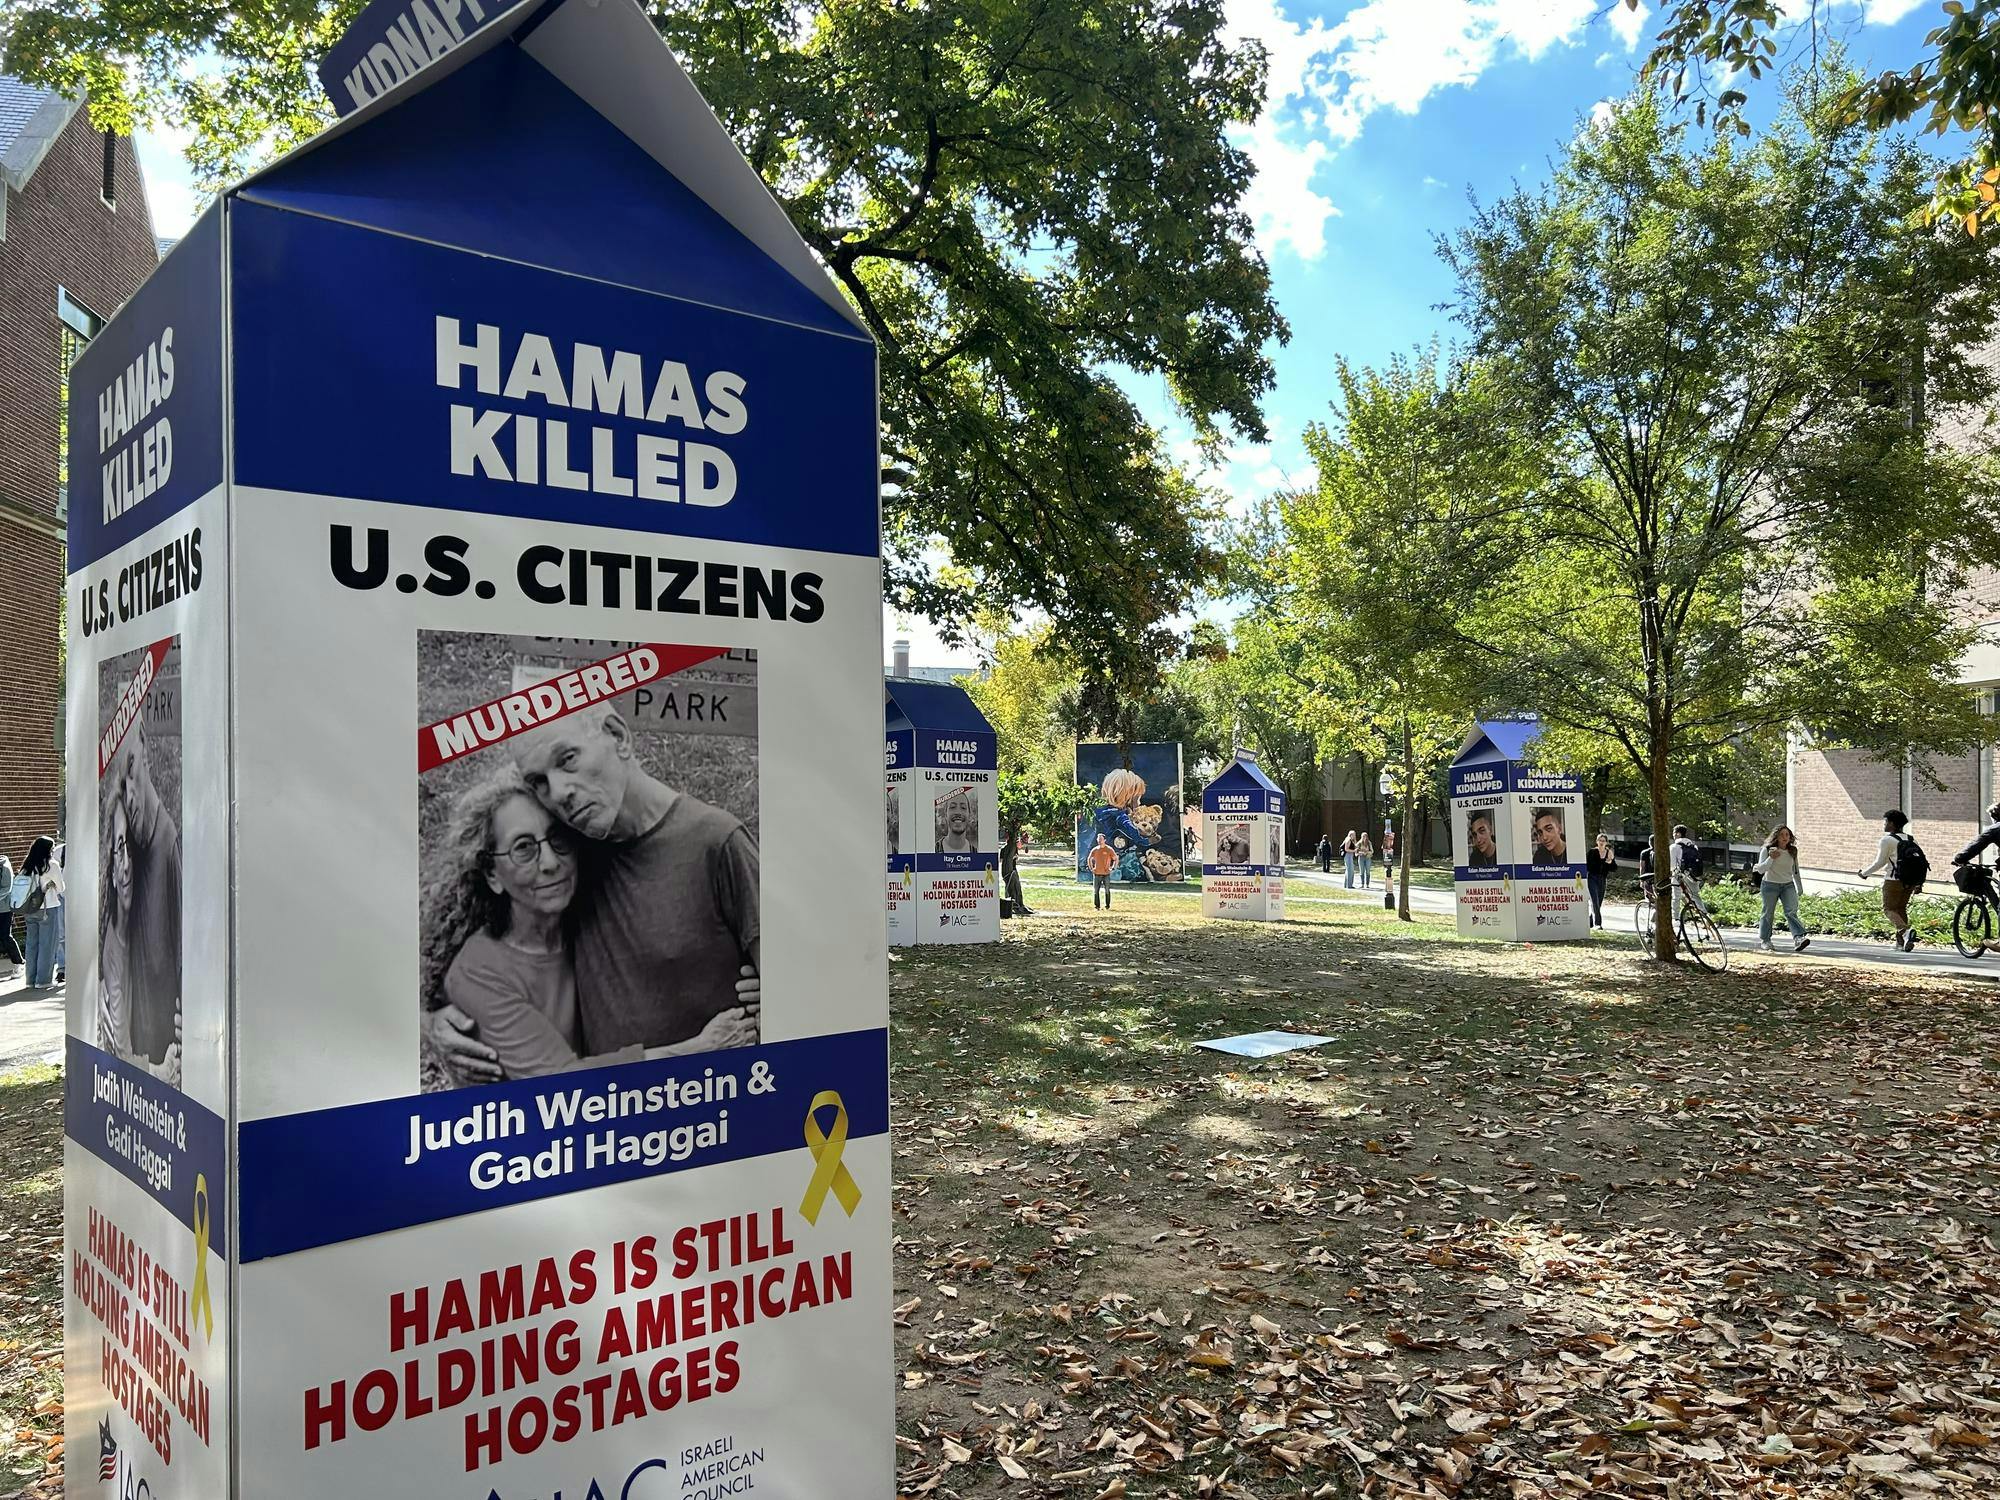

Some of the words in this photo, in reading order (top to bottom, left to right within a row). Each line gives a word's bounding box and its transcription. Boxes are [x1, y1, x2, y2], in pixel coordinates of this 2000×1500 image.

[98, 327, 174, 454] HAMAS
[436, 315, 748, 434] HAMAS
[103, 417, 173, 526] KILLED
[450, 404, 738, 507] KILLED
[82, 578, 114, 638] U.S.
[118, 527, 202, 623] CITIZENS
[330, 524, 495, 599] U.S.
[517, 545, 825, 623] CITIZENS
[101, 651, 153, 769] MURDERED
[146, 691, 173, 722] PARK
[432, 648, 660, 759] MURDERED
[635, 689, 729, 722] PARK
[936, 740, 977, 752] HAMAS
[938, 752, 975, 765] KILLED
[925, 771, 943, 781] U.S.
[946, 773, 988, 782] CITIZENS
[1456, 780, 1502, 794] KIDNAPPED
[1464, 771, 1494, 783] HAMAS
[1517, 779, 1576, 789] KIDNAPPED
[1457, 800, 1471, 808] U.S.
[1473, 797, 1503, 807] CITIZENS
[1519, 795, 1535, 803] U.S.
[1538, 796, 1575, 804] CITIZENS
[889, 882, 903, 890] STILL
[924, 891, 955, 900] HOLDING
[957, 890, 994, 899] AMERICAN
[933, 881, 957, 889] HAMAS
[959, 881, 965, 889] IS
[967, 880, 984, 889] STILL
[941, 900, 977, 910] HOSTAGES
[1560, 886, 1575, 894] STILL
[952, 915, 967, 926] IAC
[1547, 916, 1560, 925] IAC
[93, 1064, 119, 1108] Judih
[122, 1078, 174, 1144] Weinstein
[176, 1111, 186, 1152] &
[405, 1103, 525, 1164] Judih
[536, 1067, 737, 1130] Weinstein
[747, 1060, 776, 1095] &
[106, 1114, 131, 1161] Gadi
[133, 1129, 172, 1191] Haggai
[469, 1137, 573, 1190] Gadi
[586, 1111, 728, 1169] Haggai
[89, 1205, 135, 1292] HAMAS
[138, 1247, 150, 1307] IS
[153, 1264, 190, 1352] STILL
[390, 1249, 597, 1352] HAMAS
[613, 1236, 657, 1295] IS
[672, 1207, 794, 1279] STILL
[74, 1249, 129, 1348] HOLDING
[132, 1309, 209, 1448] AMERICAN
[304, 1319, 581, 1451] HOLDING
[596, 1251, 853, 1364] AMERICAN
[101, 1336, 171, 1466] HOSTAGES
[465, 1341, 740, 1472] HOSTAGES
[681, 1436, 732, 1467] ISRAELI
[681, 1448, 764, 1490] AMERICAN
